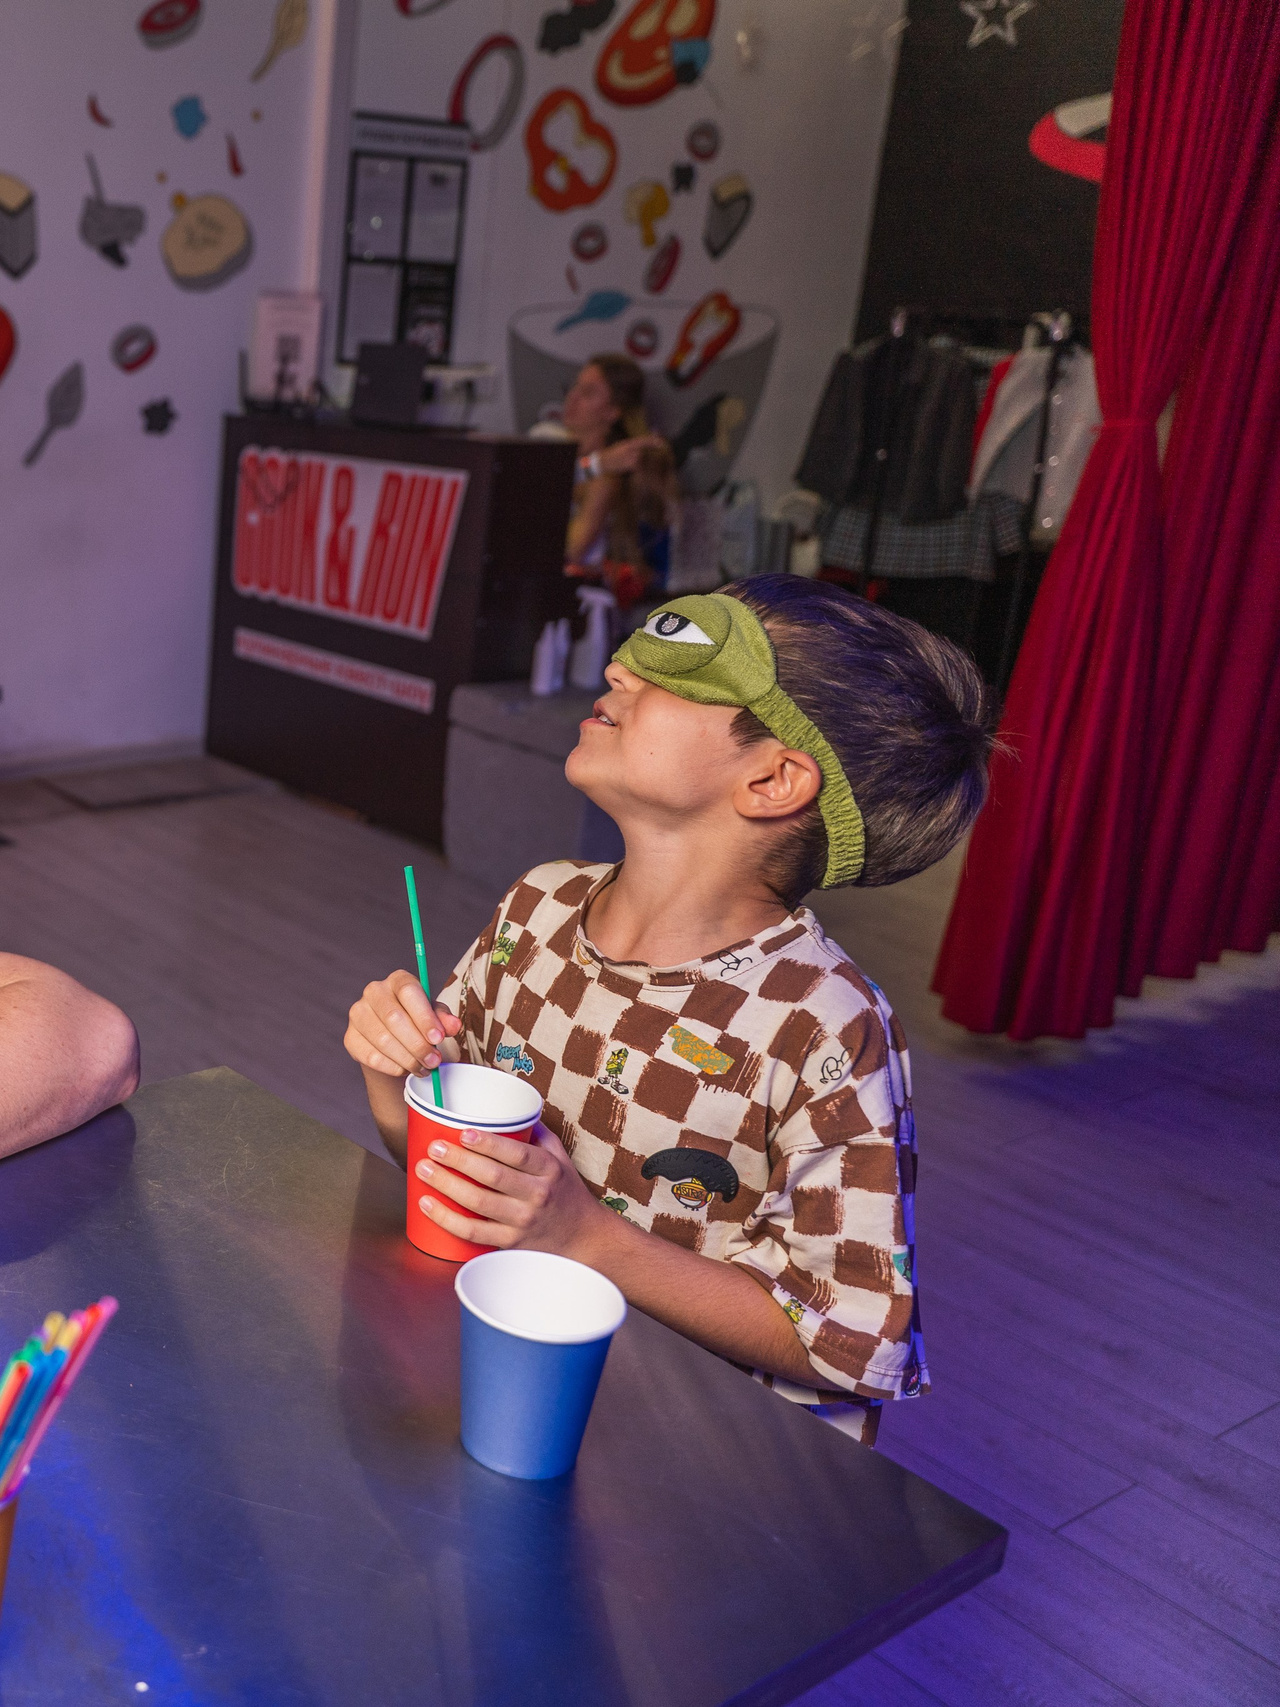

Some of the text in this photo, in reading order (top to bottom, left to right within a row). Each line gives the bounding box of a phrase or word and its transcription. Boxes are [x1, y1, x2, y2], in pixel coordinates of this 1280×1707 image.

[234, 453, 460, 632] COOK & RUN
